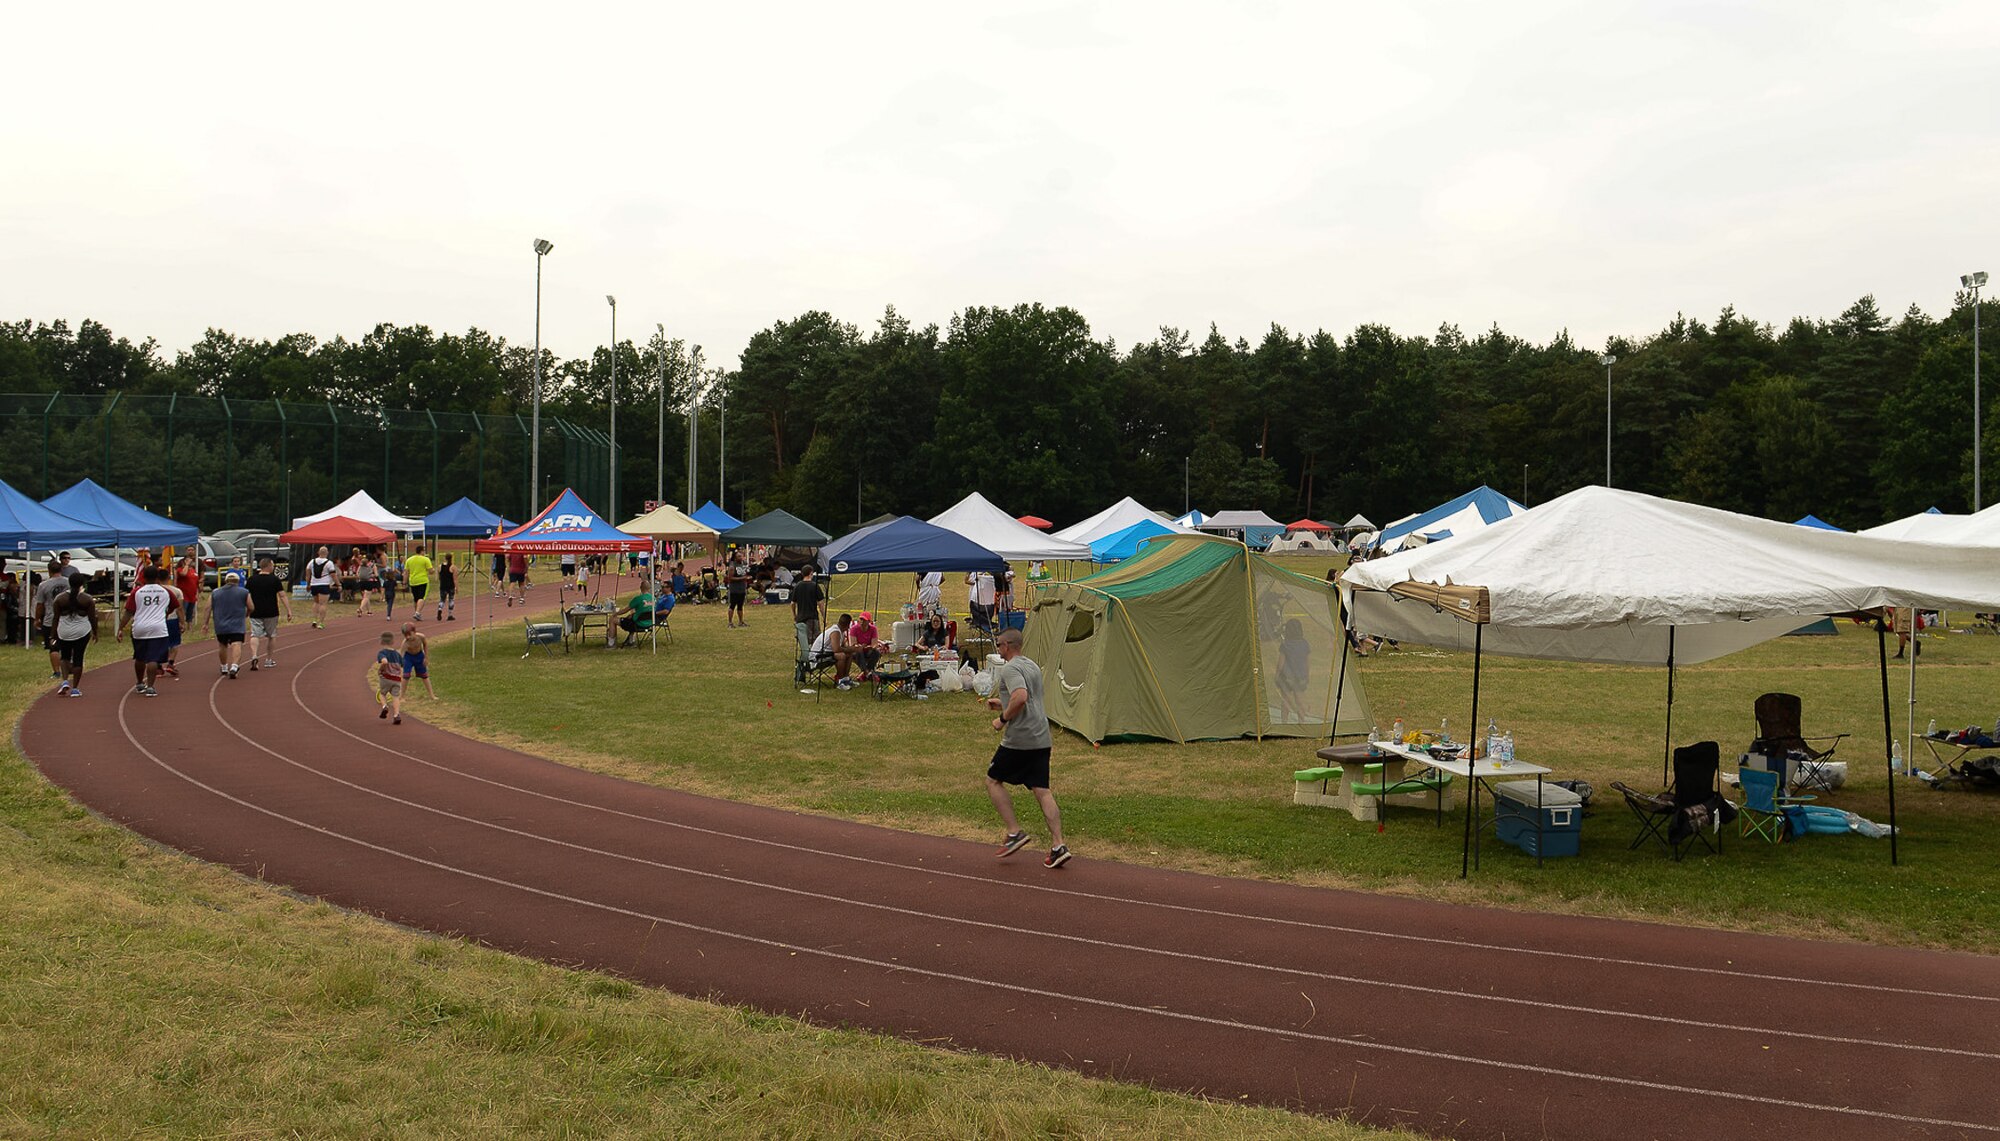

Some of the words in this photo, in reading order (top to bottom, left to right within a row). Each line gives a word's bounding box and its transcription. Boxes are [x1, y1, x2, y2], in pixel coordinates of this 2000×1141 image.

[531, 514, 593, 532] AFN
[516, 541, 614, 551] www.afneurope.net
[143, 596, 160, 607] 84
